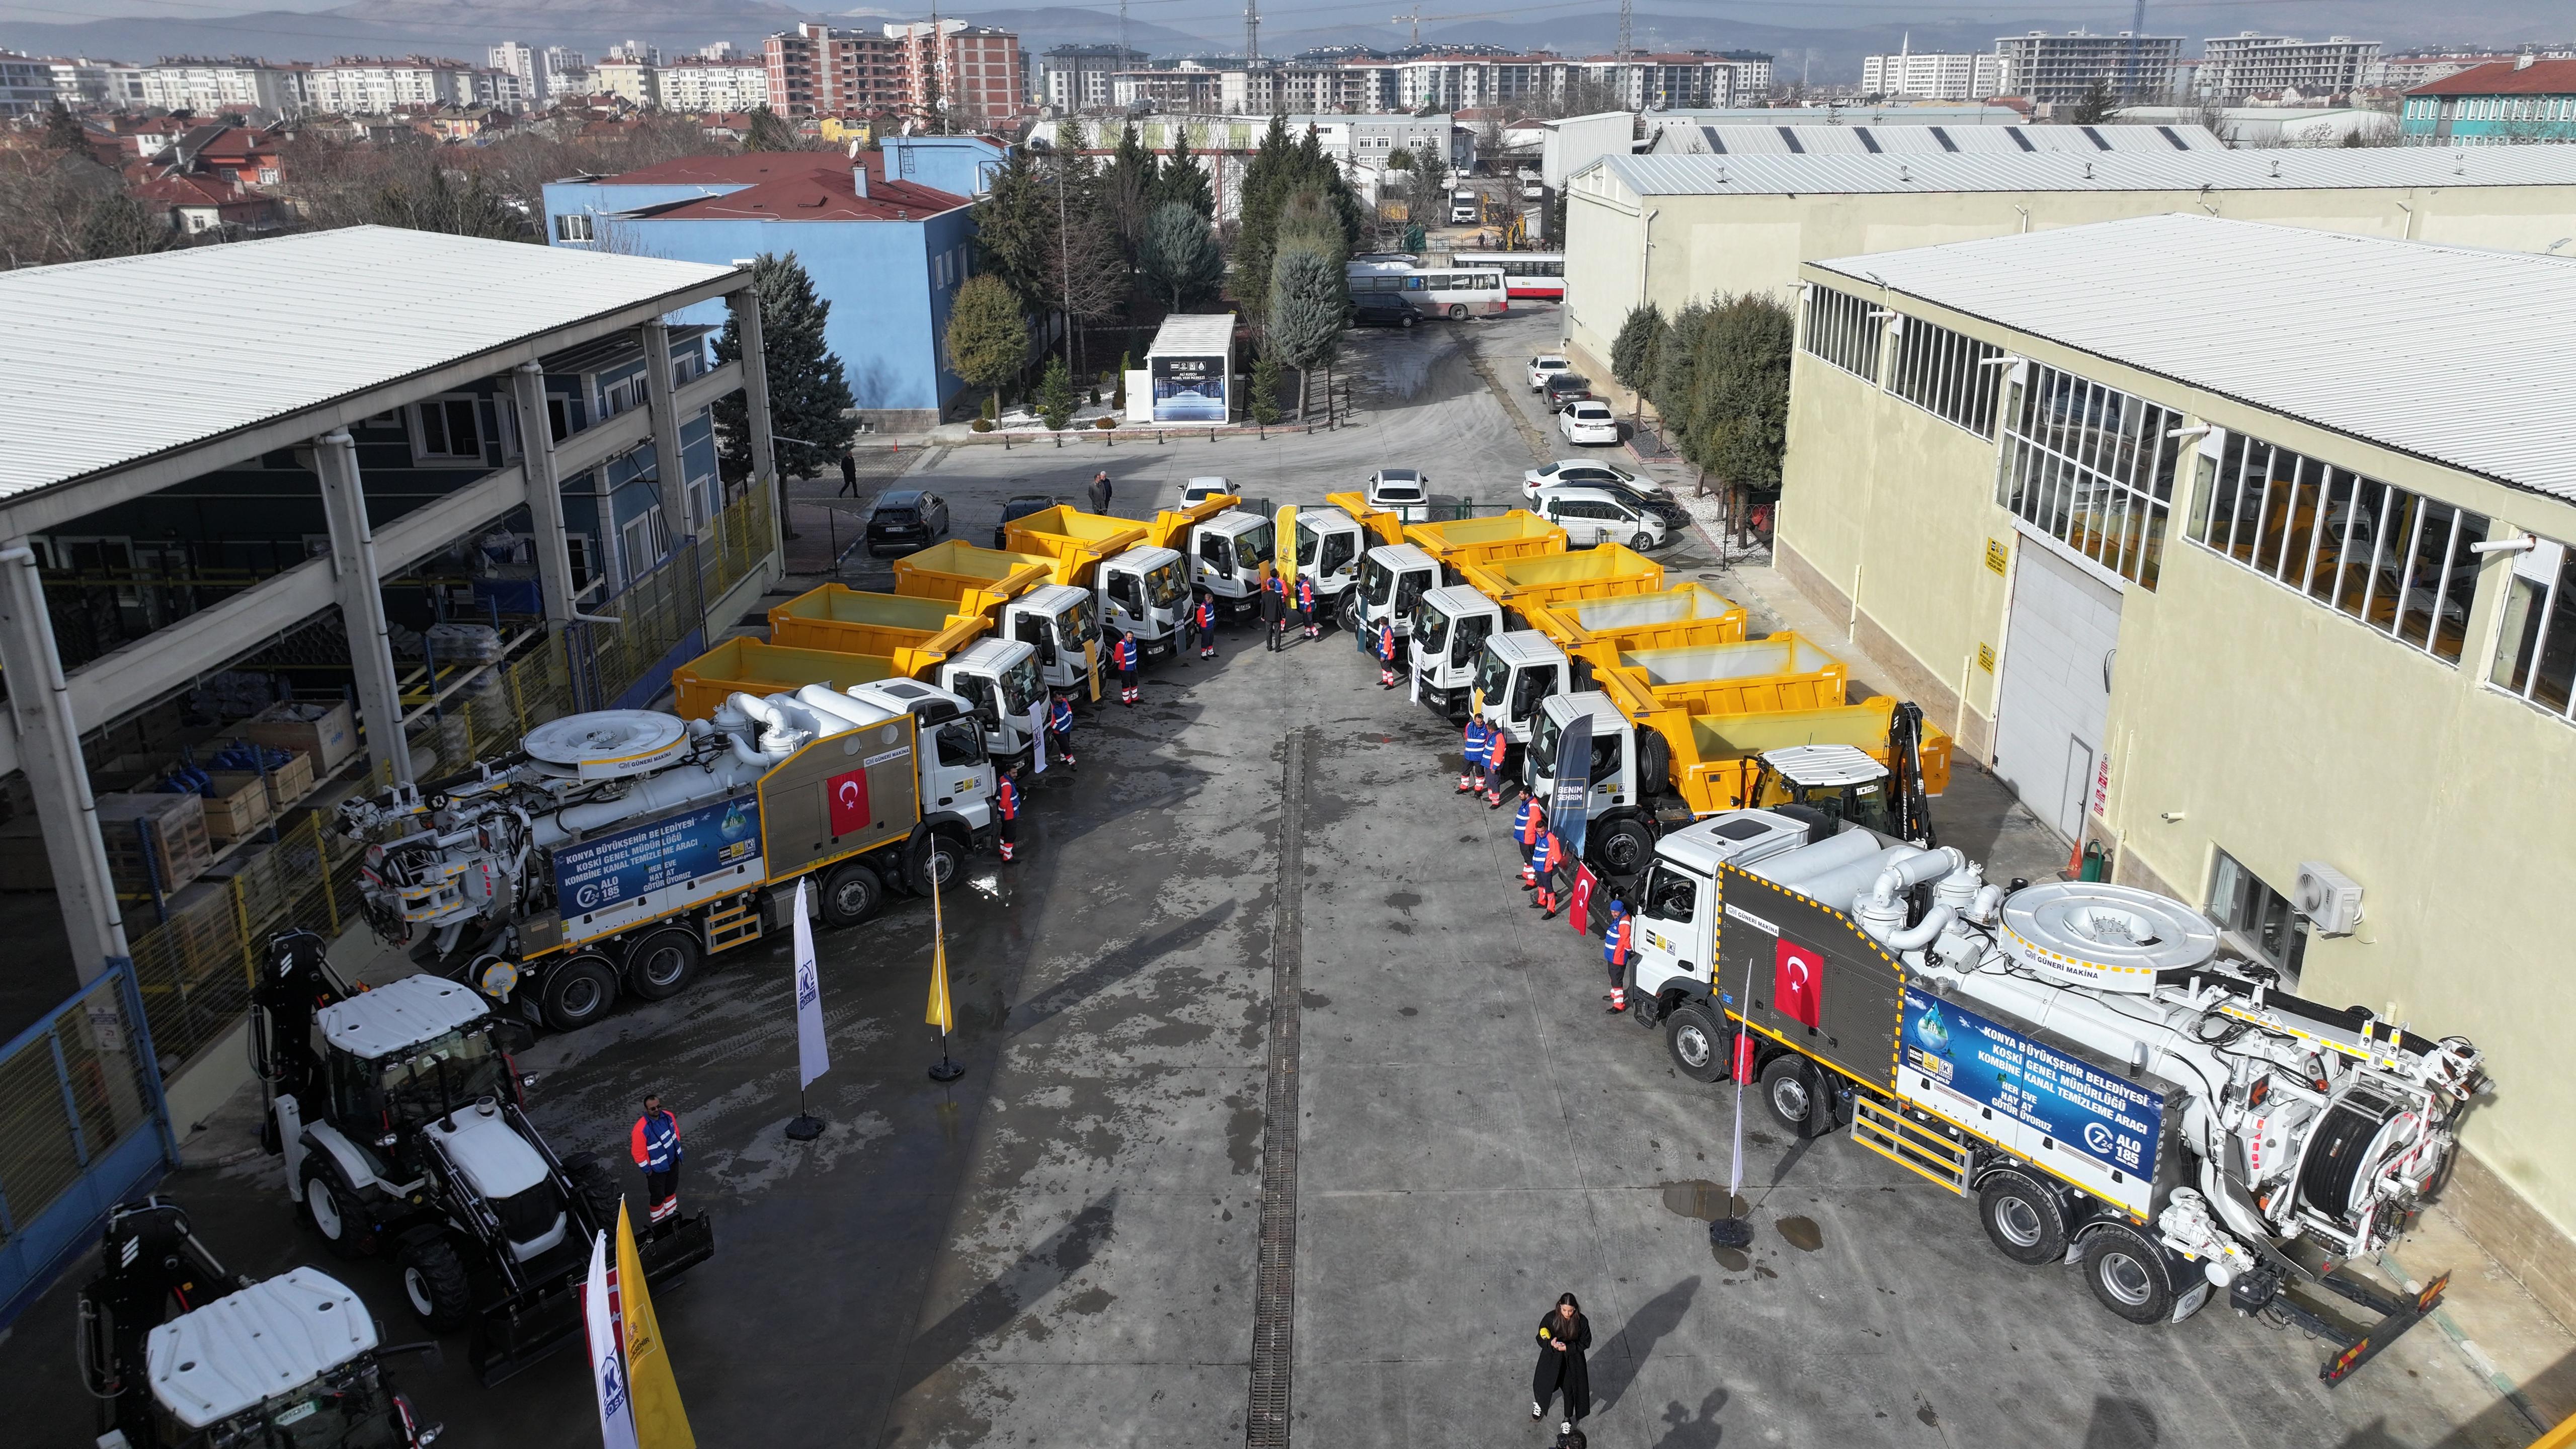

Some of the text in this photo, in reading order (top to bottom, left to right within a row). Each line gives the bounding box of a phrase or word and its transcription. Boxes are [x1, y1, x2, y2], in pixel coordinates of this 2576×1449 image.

[631, 759, 653, 767] GÜNERİ
[654, 751, 671, 761] MAKİNA
[874, 753, 892, 762] GÜNERİ
[892, 748, 910, 757] MAKİNA
[1558, 785, 1583, 793] BENİM
[567, 817, 695, 864] KONYA BÜYÜKŞEHİR BELEDİYESİ
[604, 850, 630, 862] GENEL
[632, 832, 682, 855] MÜDÜRLÜĞÜ
[565, 838, 698, 886] KOMBİNE KANAL TEMİZLEME ARACI
[649, 859, 677, 873] HER EVE
[601, 876, 619, 889] ALO
[602, 886, 620, 898] 185
[1738, 912, 1757, 924] GÜNERİ
[1758, 920, 1778, 934] MAKİNA
[2037, 956, 2064, 971] GÜNERİ
[2066, 967, 2099, 979] MAKİNA
[1909, 1062, 1950, 1085] www.koski.gov.tr
[1984, 1026, 2149, 1107] KONYA BÜYÜKŞEHİR BELEDİYESİ
[1993, 1044, 2126, 1111] KOSKİ GENEL MÜDÜRLÜĞÜ
[1978, 1051, 2148, 1135] KOMBİNE KANAL TEMİZLEME ARACI
[2002, 1081, 2037, 1104] HER EVE
[2116, 1134, 2141, 1153] ALO
[2116, 1146, 2139, 1164] 185
[604, 1365, 618, 1399] K
